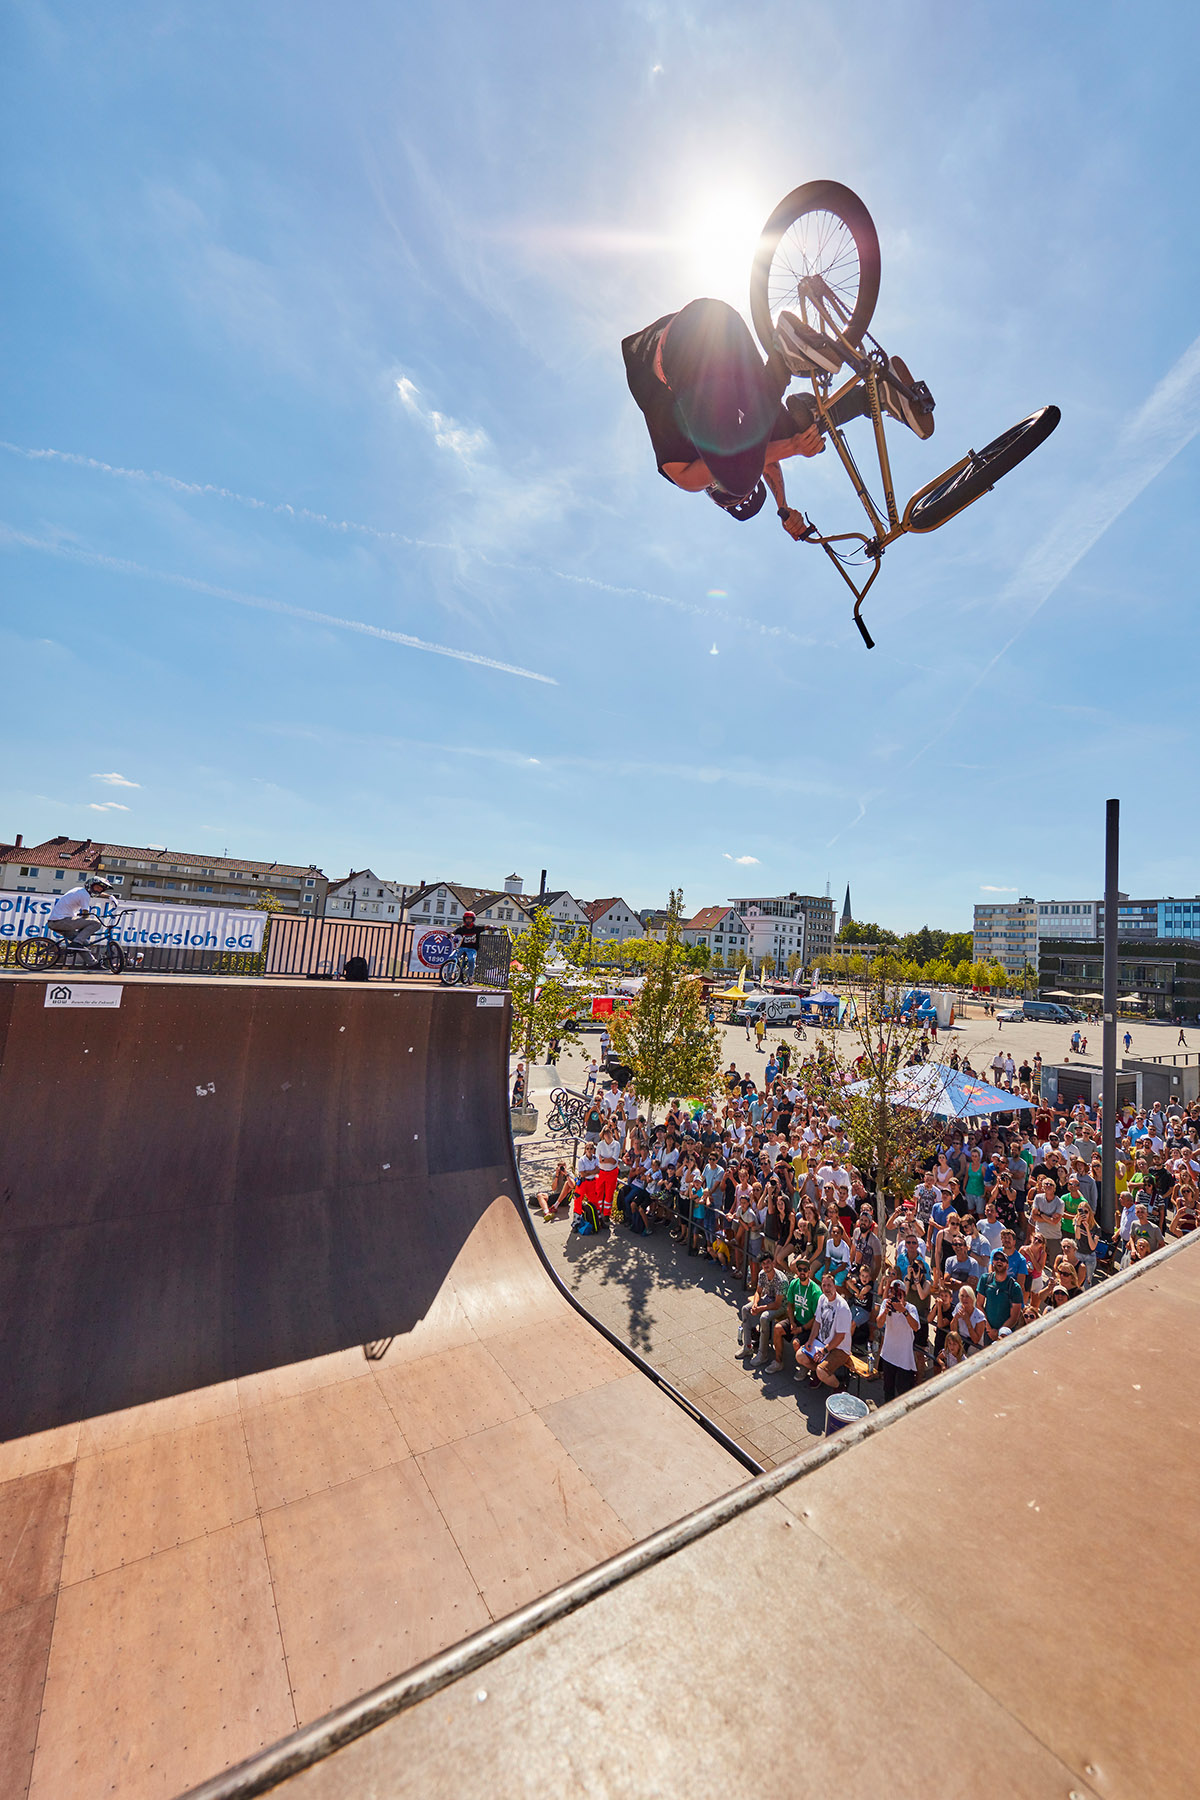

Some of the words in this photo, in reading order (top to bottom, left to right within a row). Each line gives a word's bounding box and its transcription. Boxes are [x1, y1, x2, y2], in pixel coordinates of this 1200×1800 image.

[885, 491, 898, 527] VANS
[0, 896, 117, 920] olksnk
[225, 934, 253, 949] eG
[424, 944, 450, 955] TSVE
[428, 955, 445, 963] 1890
